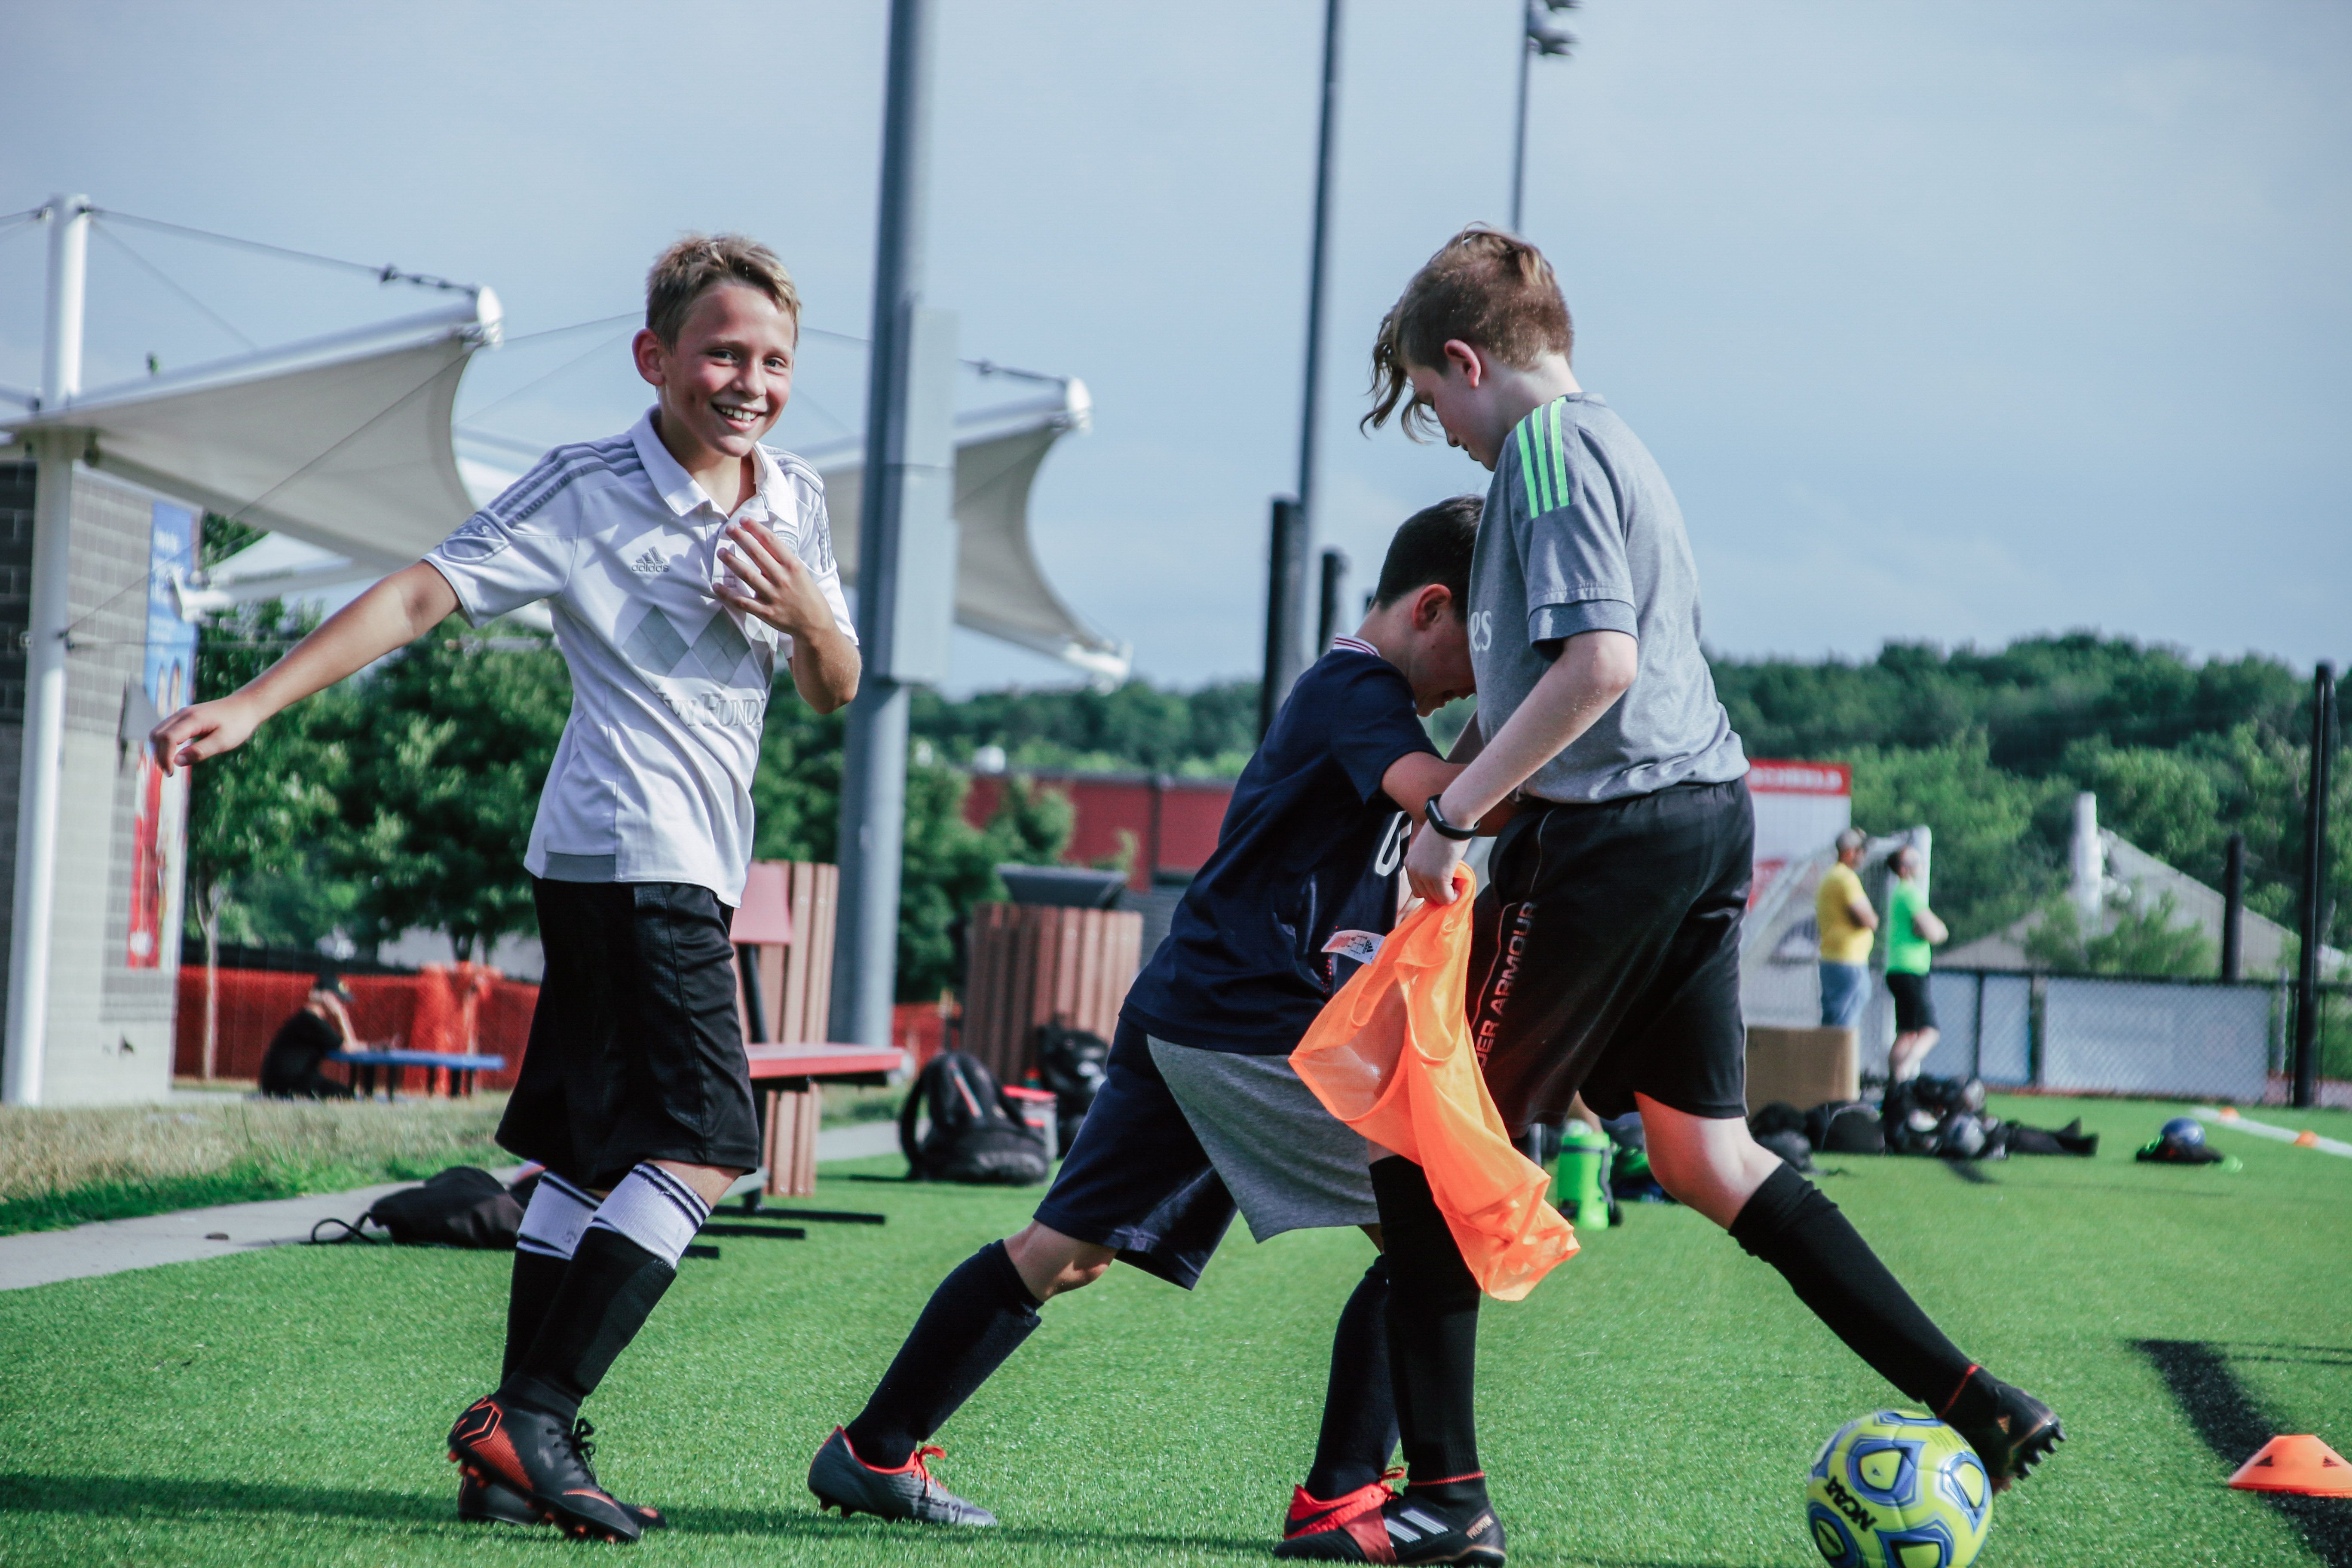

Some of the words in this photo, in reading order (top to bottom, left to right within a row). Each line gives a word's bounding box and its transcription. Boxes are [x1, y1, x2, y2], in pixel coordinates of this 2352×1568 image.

[631, 563, 669, 572] adidas
[1491, 902, 1536, 1016] ARMOUR
[1824, 1475, 1877, 1532] NCAA
